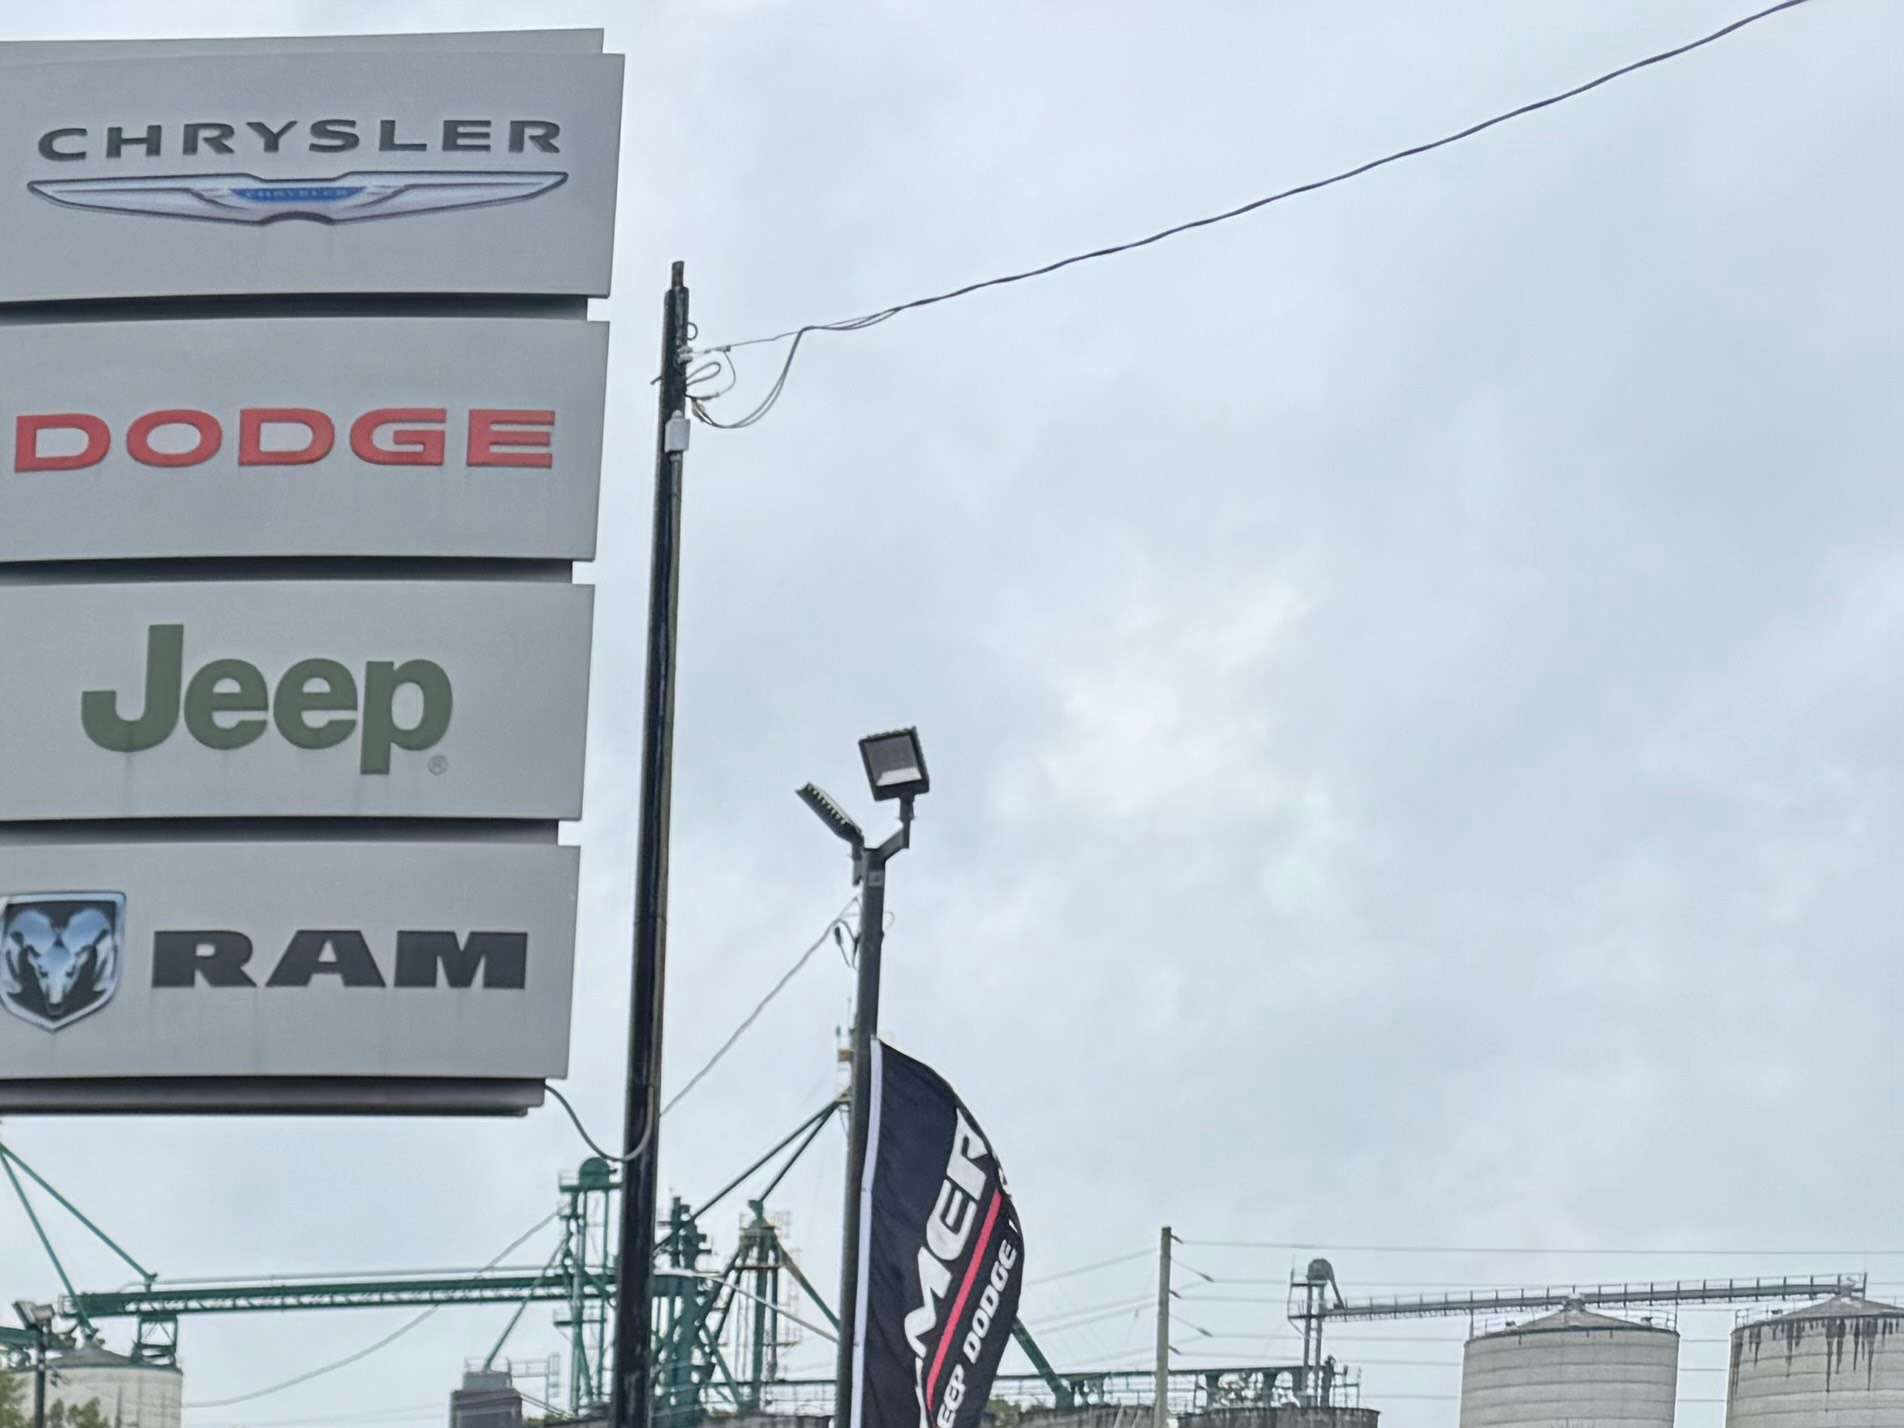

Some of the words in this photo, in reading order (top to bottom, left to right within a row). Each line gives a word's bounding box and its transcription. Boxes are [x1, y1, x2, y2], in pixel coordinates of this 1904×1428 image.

[38, 119, 561, 161] CHRYSLER
[14, 408, 556, 472] DODGE
[81, 624, 453, 775] Jeep
[151, 930, 528, 989] RAM
[963, 1239, 1017, 1363] DODGE
